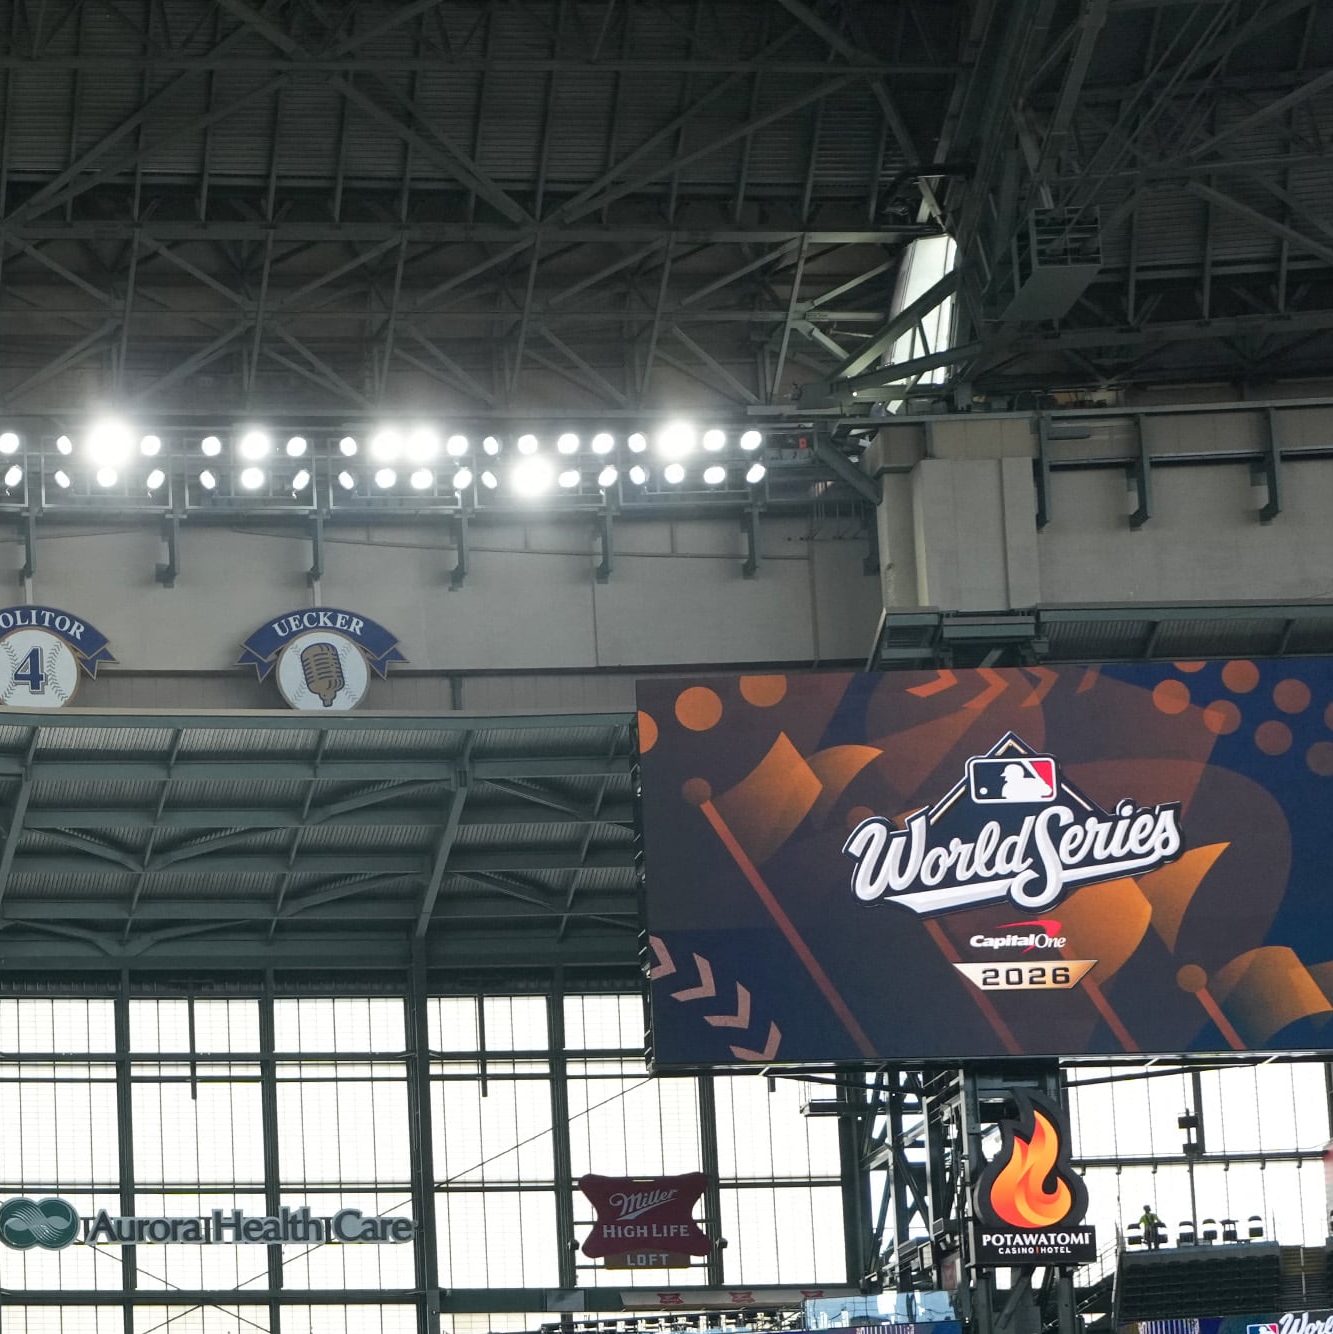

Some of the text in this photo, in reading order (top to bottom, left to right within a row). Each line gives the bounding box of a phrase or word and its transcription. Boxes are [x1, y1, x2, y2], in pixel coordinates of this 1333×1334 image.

[272, 611, 364, 637] UECKER
[13, 645, 47, 695] 4
[852, 818, 1034, 902] World
[981, 966, 1072, 987] 2026
[608, 1188, 679, 1221] Miller
[85, 1205, 416, 1244] Aurora Health Care
[602, 1222, 690, 1239] HIGH LIFE
[981, 1232, 1091, 1247] POTAWATOMI
[998, 1246, 1072, 1255] CASINO HOTEL
[626, 1253, 668, 1266] LOFT
